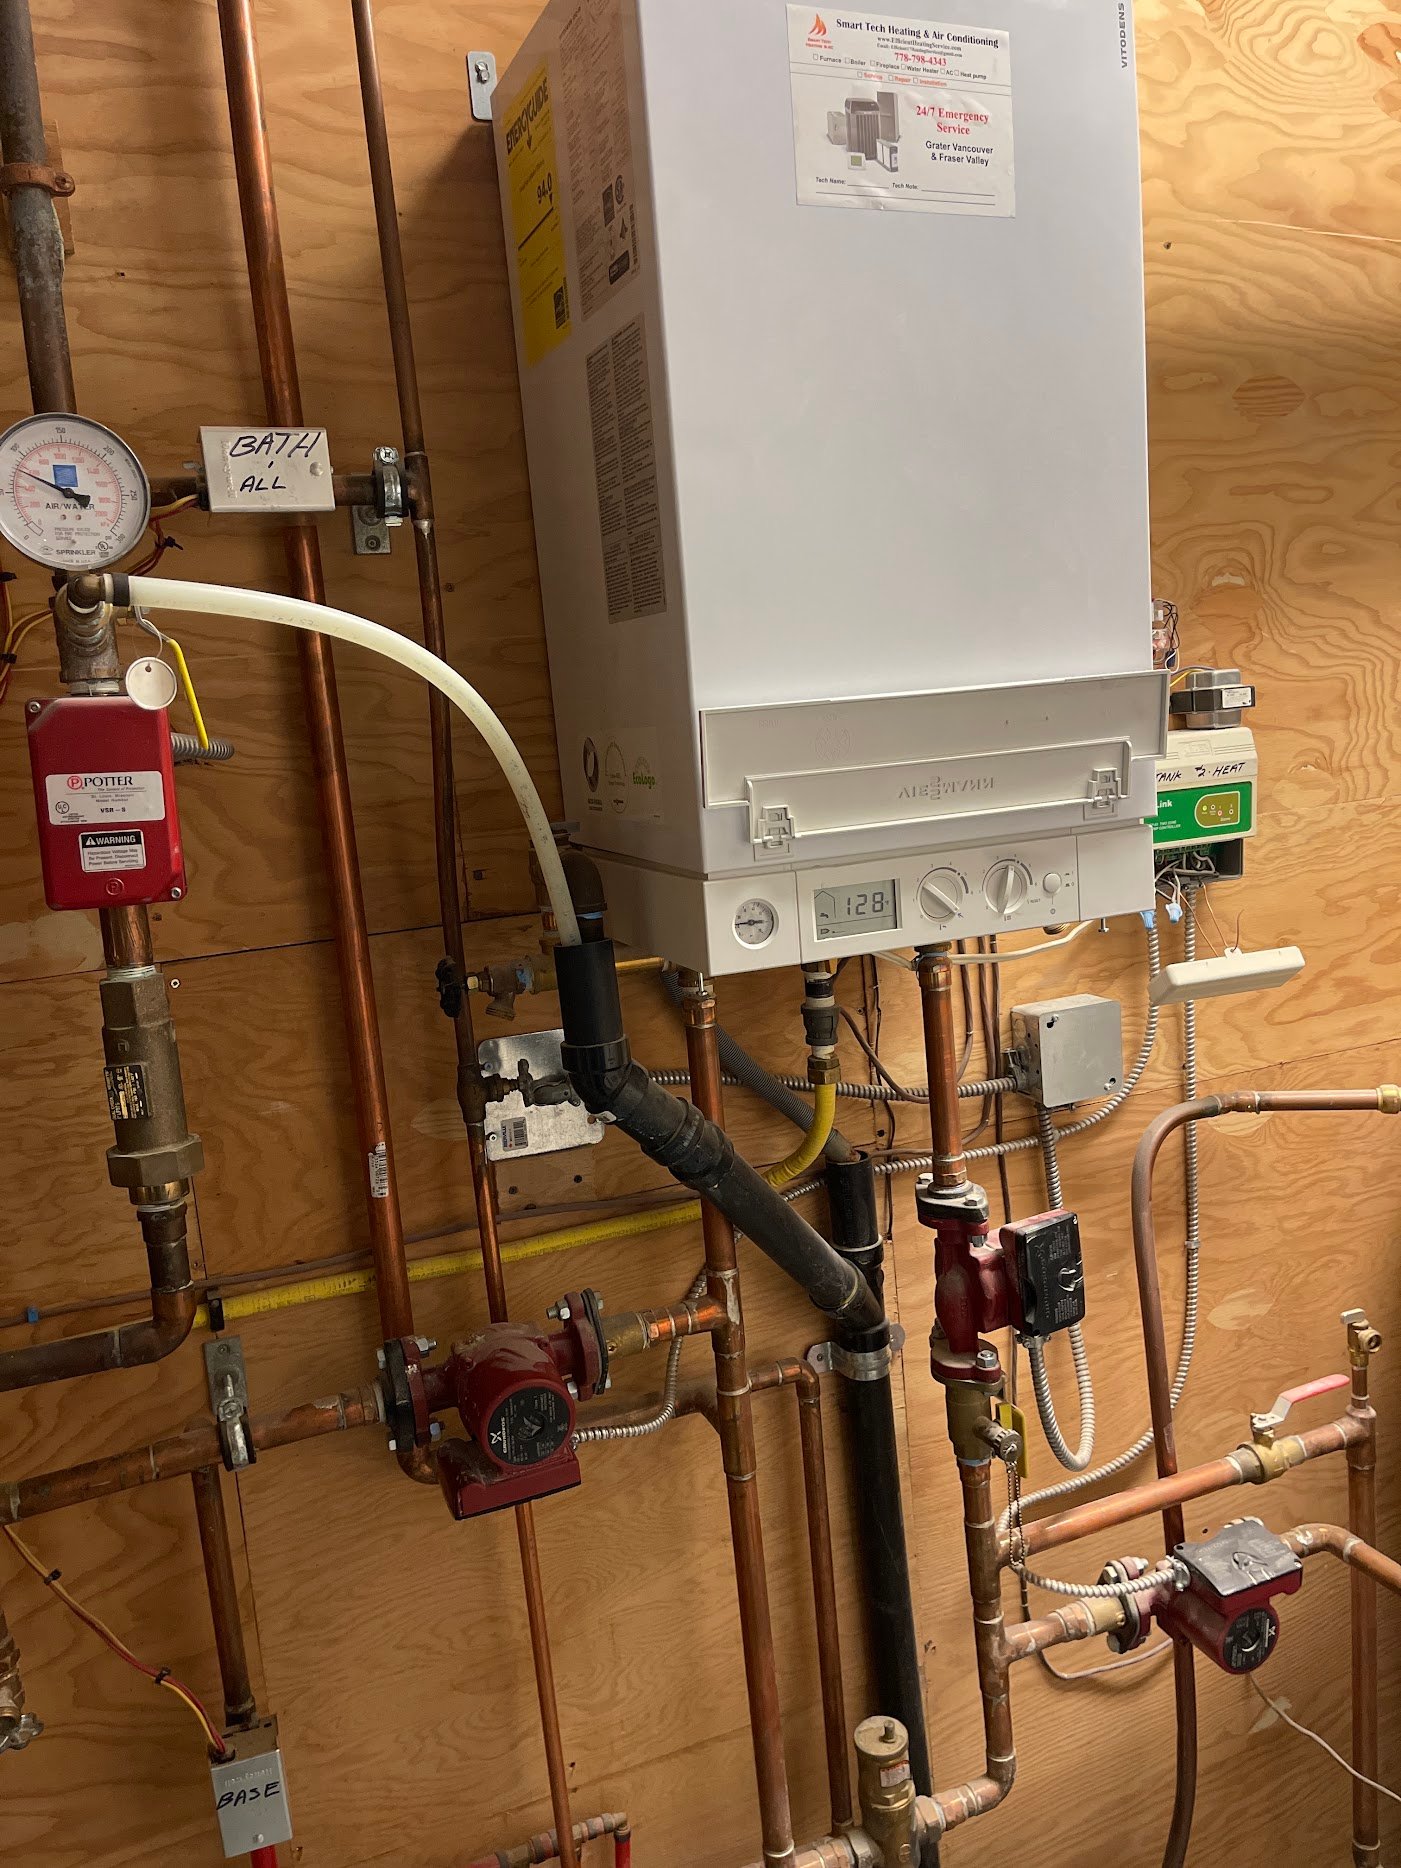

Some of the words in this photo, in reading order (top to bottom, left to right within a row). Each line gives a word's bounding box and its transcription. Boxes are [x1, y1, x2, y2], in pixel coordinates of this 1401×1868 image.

[836, 18, 862, 30] Smart
[865, 22, 886, 34] Tech
[888, 25, 920, 38] Heating
[924, 30, 930, 38] &
[932, 30, 944, 40] Air
[946, 33, 999, 48] Conditioning
[1118, 3, 1128, 68] VITODENS
[820, 56, 842, 64] Furnace
[876, 62, 900, 70] Fireplace
[894, 52, 947, 66] 778-798-4343
[916, 106, 935, 116] 24/7
[938, 108, 989, 124] Emergency
[937, 122, 970, 134] Service
[926, 140, 950, 150] Grater
[952, 143, 993, 154] Vancouver
[939, 153, 964, 163] Fraser
[966, 155, 989, 166] Valley
[536, 172, 552, 204] 94.0
[103, 446, 114, 456] 200
[230, 432, 321, 458] BATH
[240, 475, 286, 492] ALL
[1156, 770, 1181, 782] TANK
[1213, 762, 1246, 776] HEAT
[84, 776, 133, 787] POTTER
[96, 835, 136, 845] WARNING
[846, 892, 884, 915] 128
[216, 1781, 280, 1810] BASE
